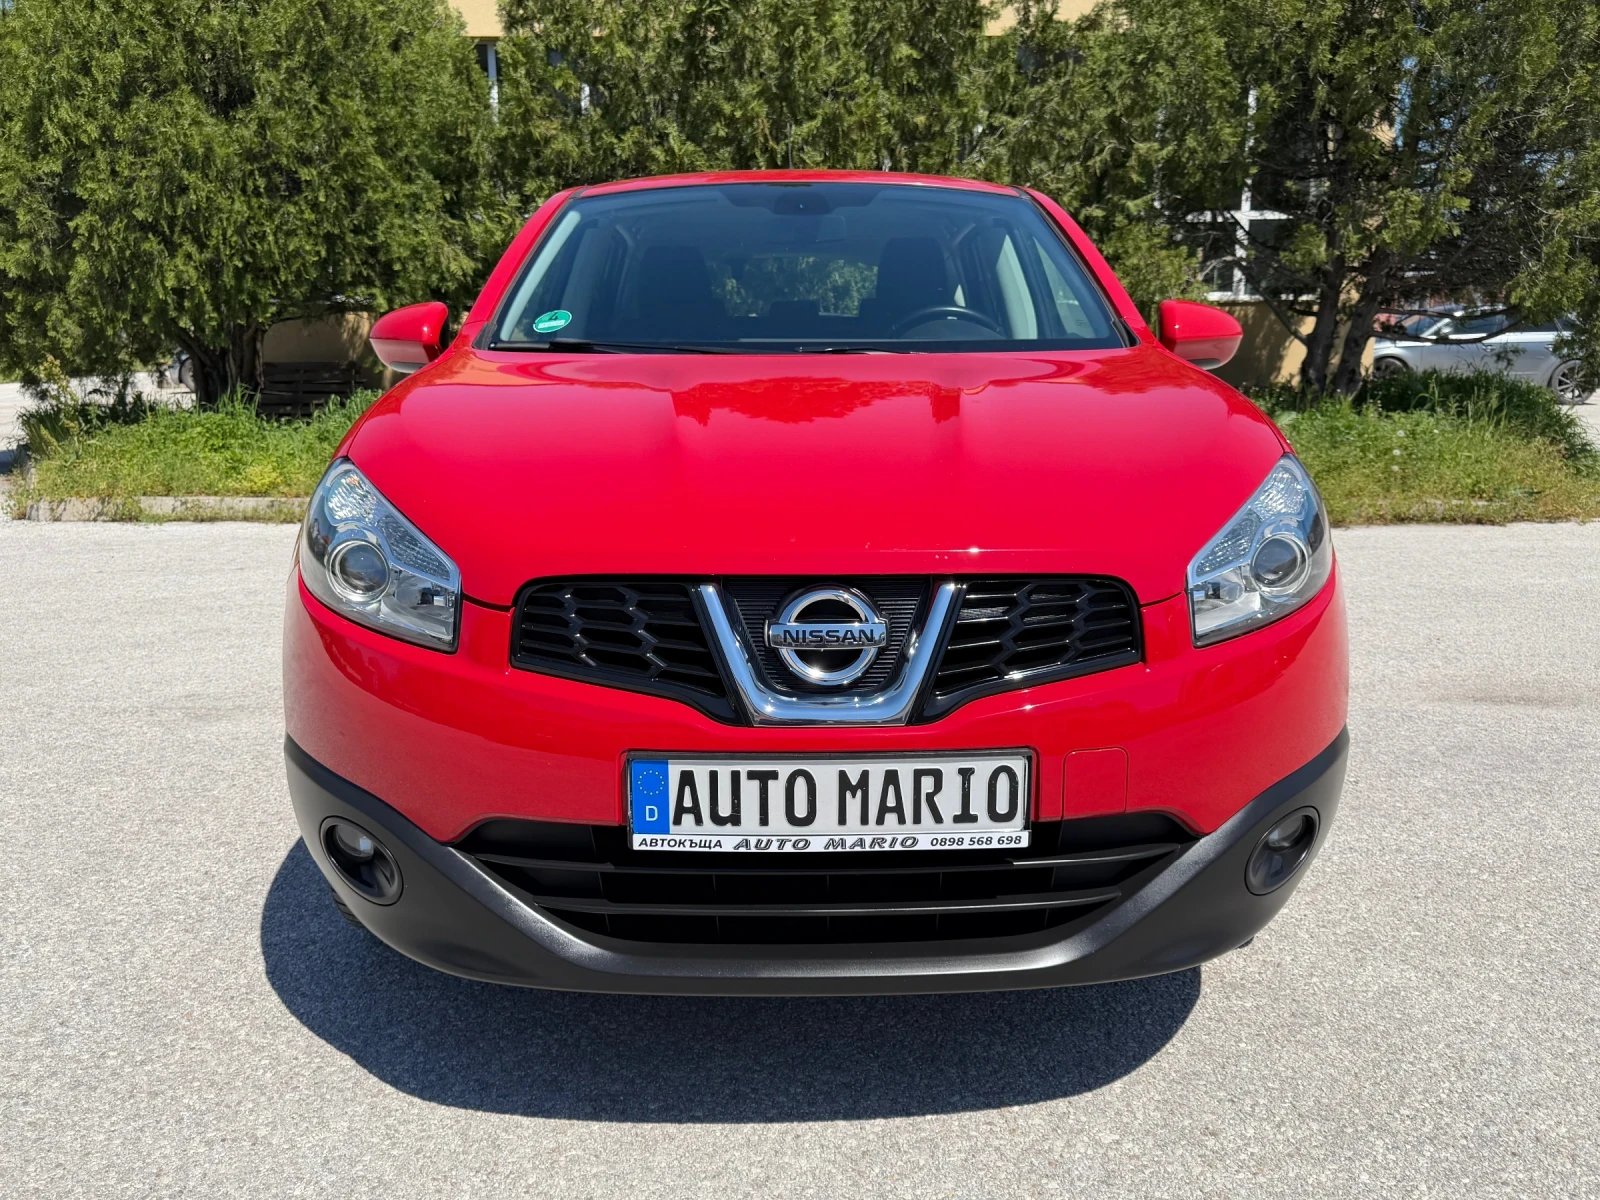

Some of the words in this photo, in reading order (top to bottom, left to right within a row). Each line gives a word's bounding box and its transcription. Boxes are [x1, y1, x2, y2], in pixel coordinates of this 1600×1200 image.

[548, 311, 559, 321] 4
[783, 629, 875, 644] NISSAN
[672, 768, 817, 827] AUTO
[838, 765, 1019, 826] MARIO
[645, 806, 658, 821] D
[638, 838, 723, 849] АВТОКЪЩА
[733, 838, 811, 851] AUTO
[823, 836, 919, 850] MARIO
[930, 837, 965, 847] 0898
[968, 837, 993, 847] 568
[997, 835, 1022, 846] 698
